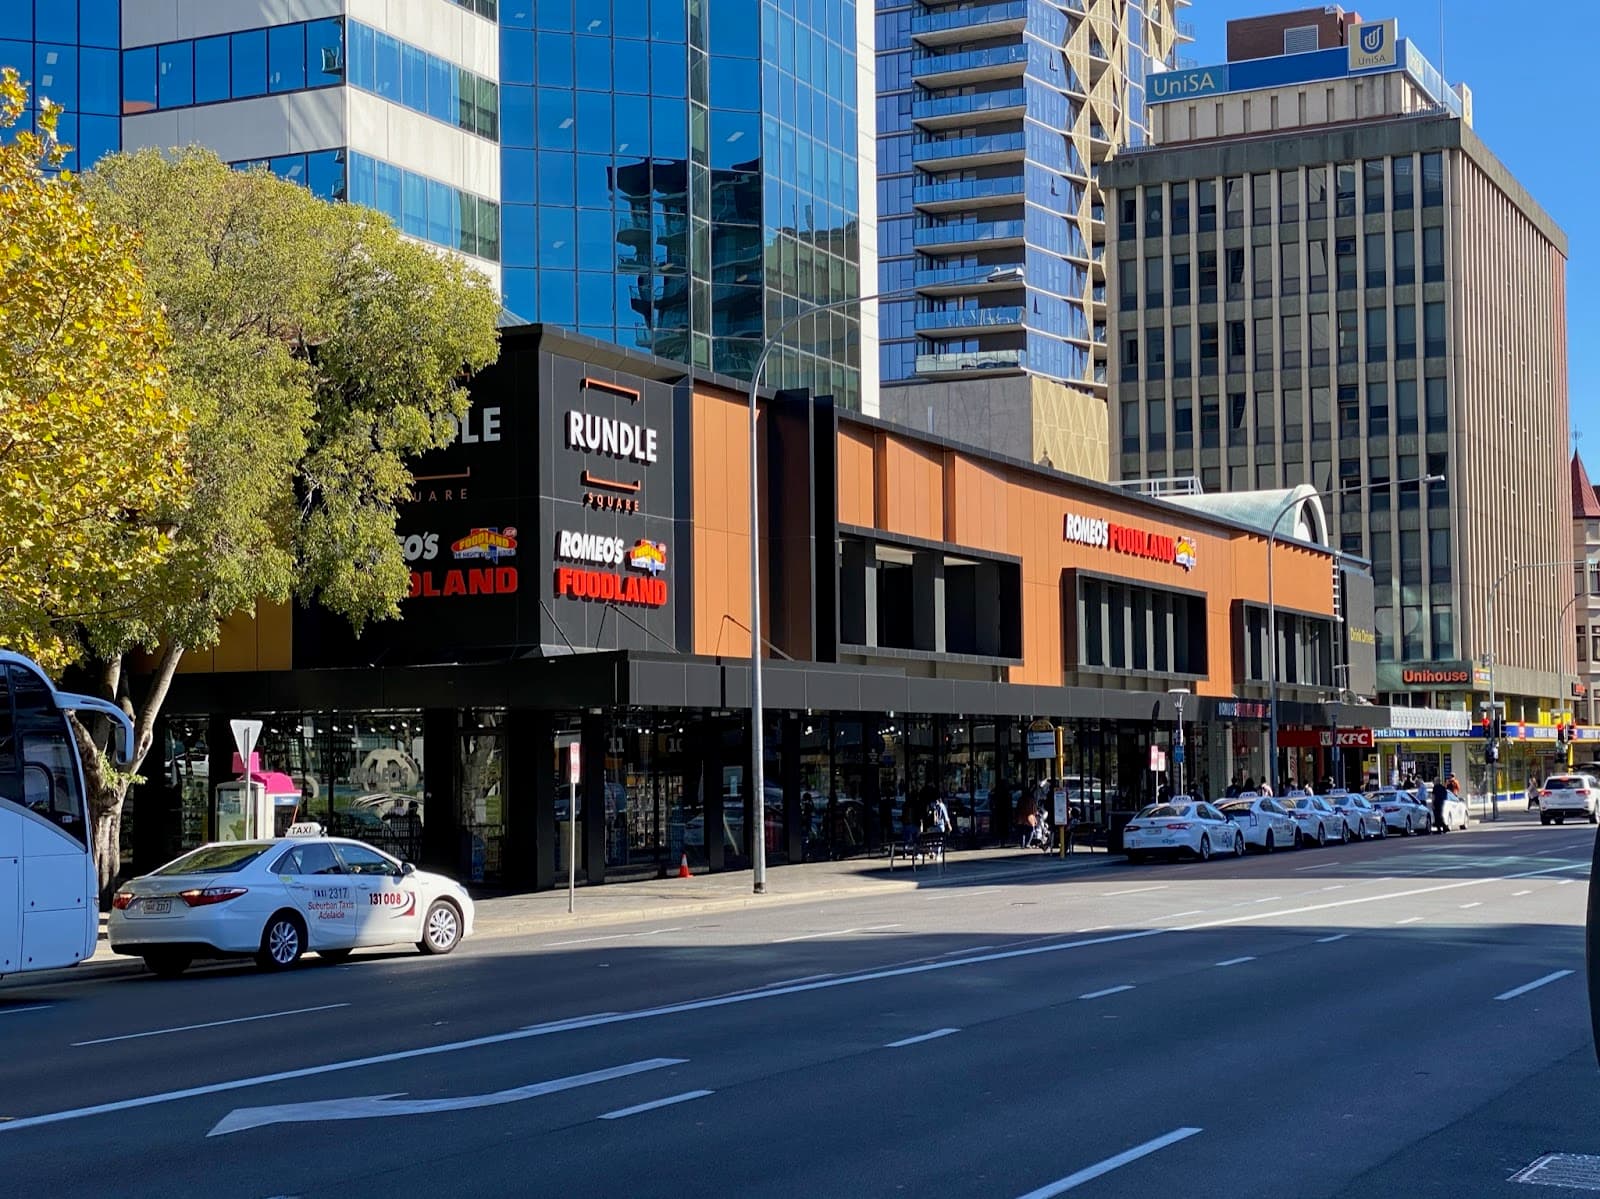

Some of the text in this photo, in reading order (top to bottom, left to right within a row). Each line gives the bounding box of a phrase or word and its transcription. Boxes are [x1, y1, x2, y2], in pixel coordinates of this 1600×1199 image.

[1358, 54, 1386, 66] UniSA
[1154, 70, 1215, 97] UniSA
[569, 410, 657, 462] RUNDLE
[588, 492, 640, 512] SQUARE
[1066, 513, 1108, 547] ROMEO'S
[1109, 524, 1175, 561] FOODLAND
[560, 530, 624, 564] ROMEO'S
[559, 568, 667, 605] FOODLAND
[1403, 670, 1468, 683] Unihouse
[1336, 733, 1368, 745] KFC
[292, 826, 312, 835] TAXI
[328, 887, 349, 899] 2317
[368, 893, 401, 905] 131 008
[308, 901, 355, 911] Suburban Taxis
[319, 911, 345, 920] Adelaide
